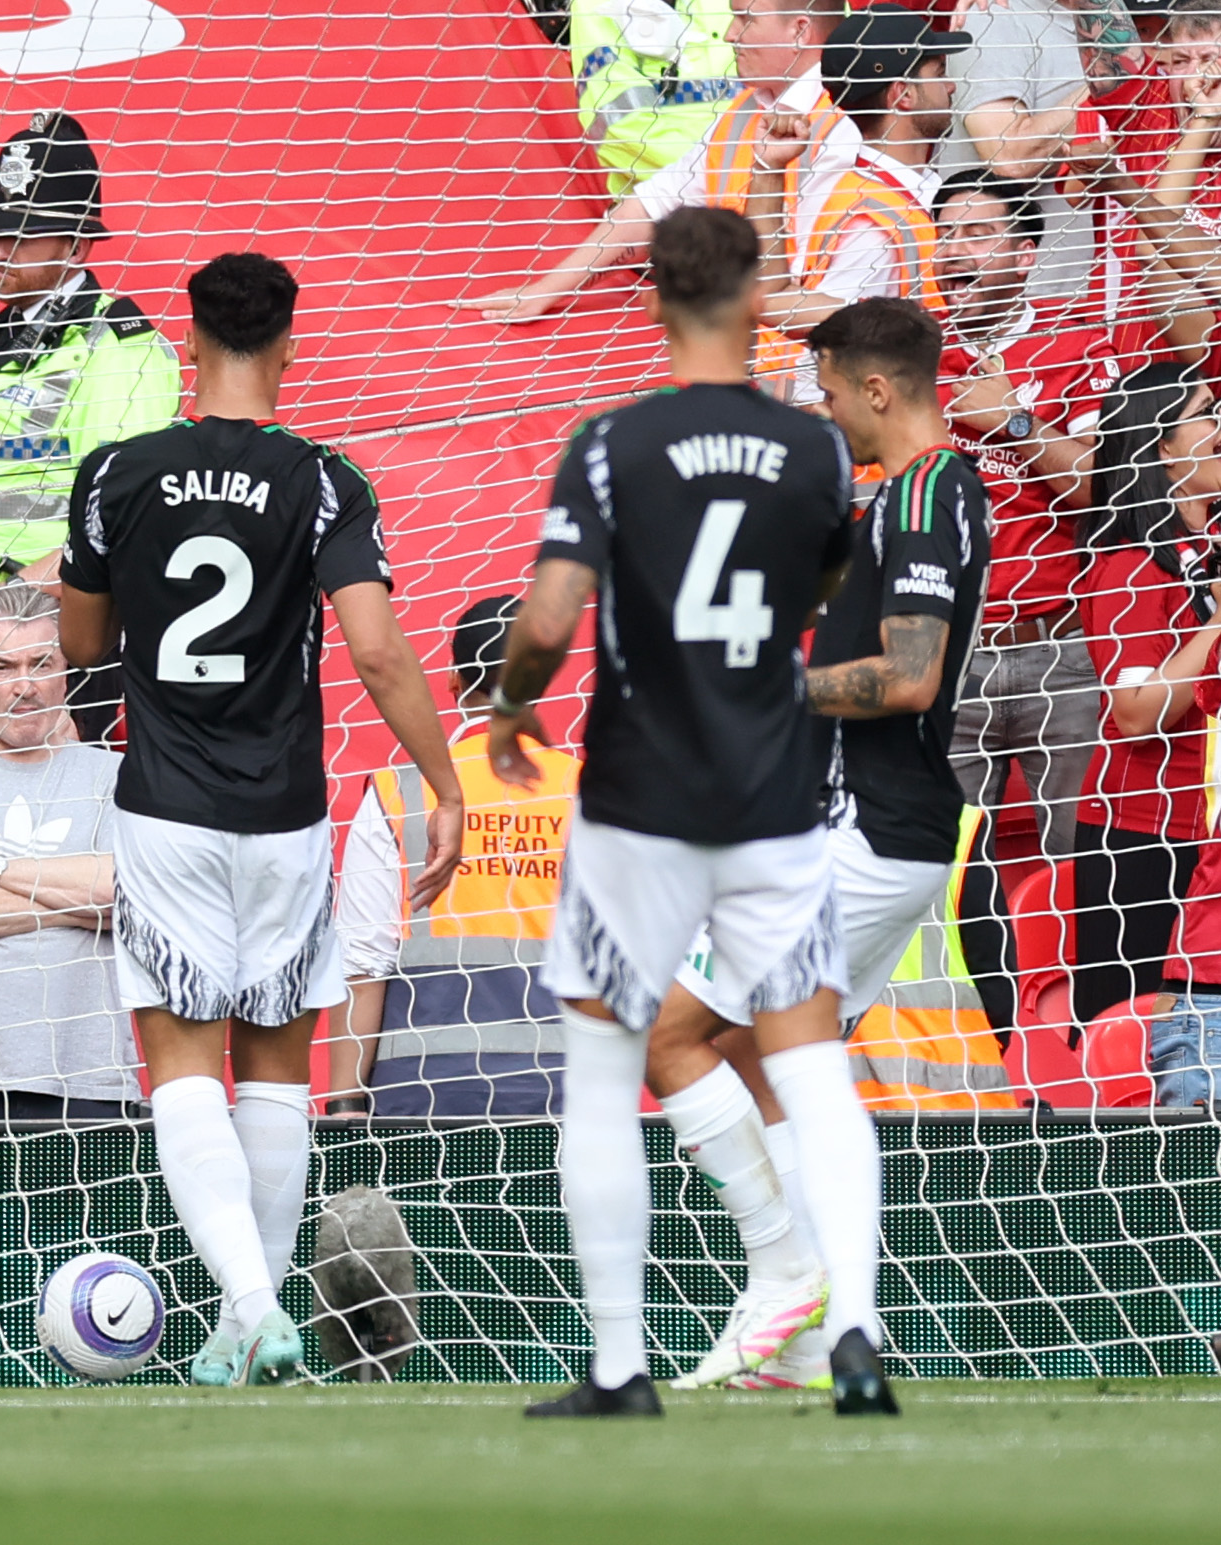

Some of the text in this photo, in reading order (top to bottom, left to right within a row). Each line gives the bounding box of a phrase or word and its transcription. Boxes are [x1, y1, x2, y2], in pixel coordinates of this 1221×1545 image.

[666, 433, 788, 484] WHITE
[160, 469, 271, 514] SALIBA
[673, 499, 774, 669] 4
[908, 562, 948, 583] VISIT
[156, 535, 254, 683] 2
[467, 812, 563, 836] DEPUTY
[482, 835, 548, 856] HEAD
[458, 856, 558, 880] STEWAR
